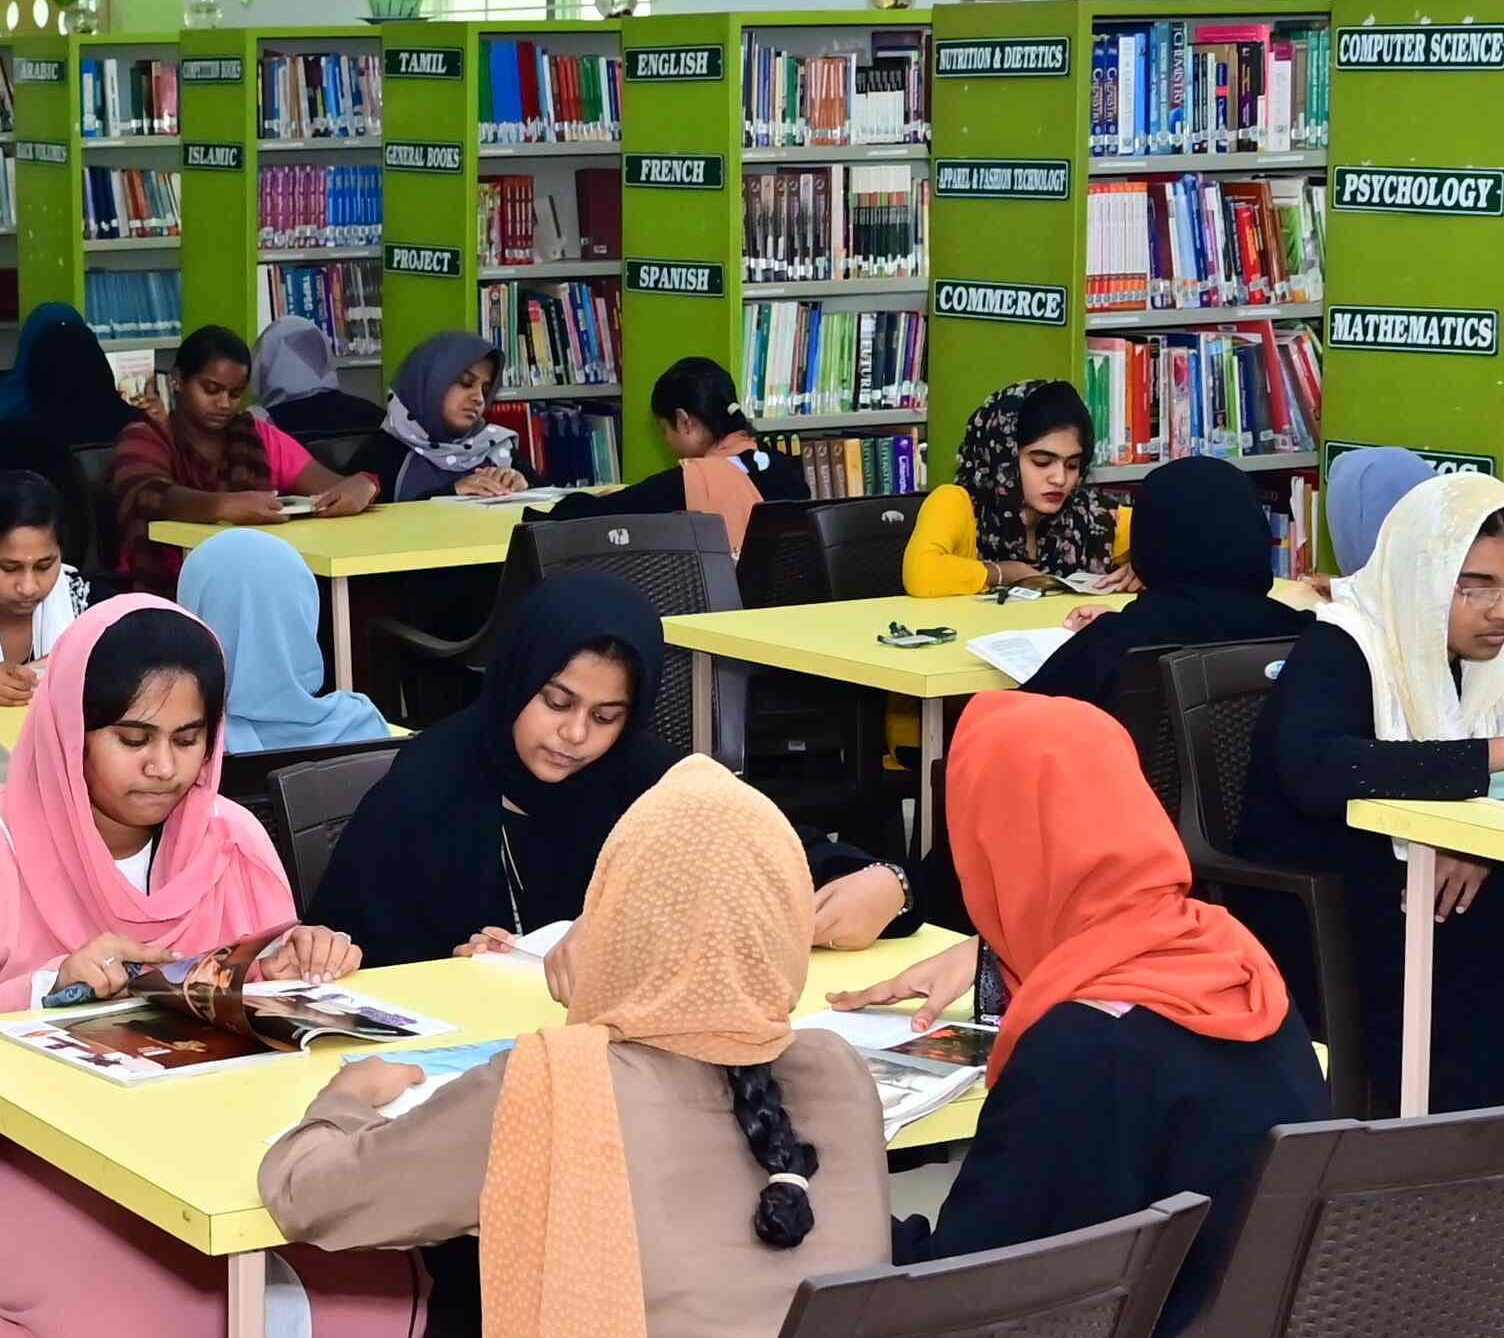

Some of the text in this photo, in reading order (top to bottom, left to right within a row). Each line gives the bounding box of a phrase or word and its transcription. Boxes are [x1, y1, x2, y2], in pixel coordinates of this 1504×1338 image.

[939, 44, 1064, 71] NUTRITION & DIETETICS
[1339, 32, 1504, 64] COMPUTER SCIENCE
[19, 62, 59, 81] ARABIC
[399, 52, 448, 75] TAMIL
[637, 51, 709, 77] ENGLISH
[187, 146, 238, 167] ISLAMIC
[385, 145, 460, 169] GENERAL BOOKS
[639, 158, 705, 184] FRENCH
[939, 166, 970, 191] APPAREL
[979, 168, 1011, 192] FASHION
[1012, 169, 1067, 193] TECHNOLOGY
[1342, 173, 1495, 209] PSYCHOLOGY
[392, 248, 452, 273] PROJECT
[638, 265, 710, 291] SPANISH
[939, 284, 1062, 319] COMMERCE
[1332, 314, 1493, 349] MATHEMATICS
